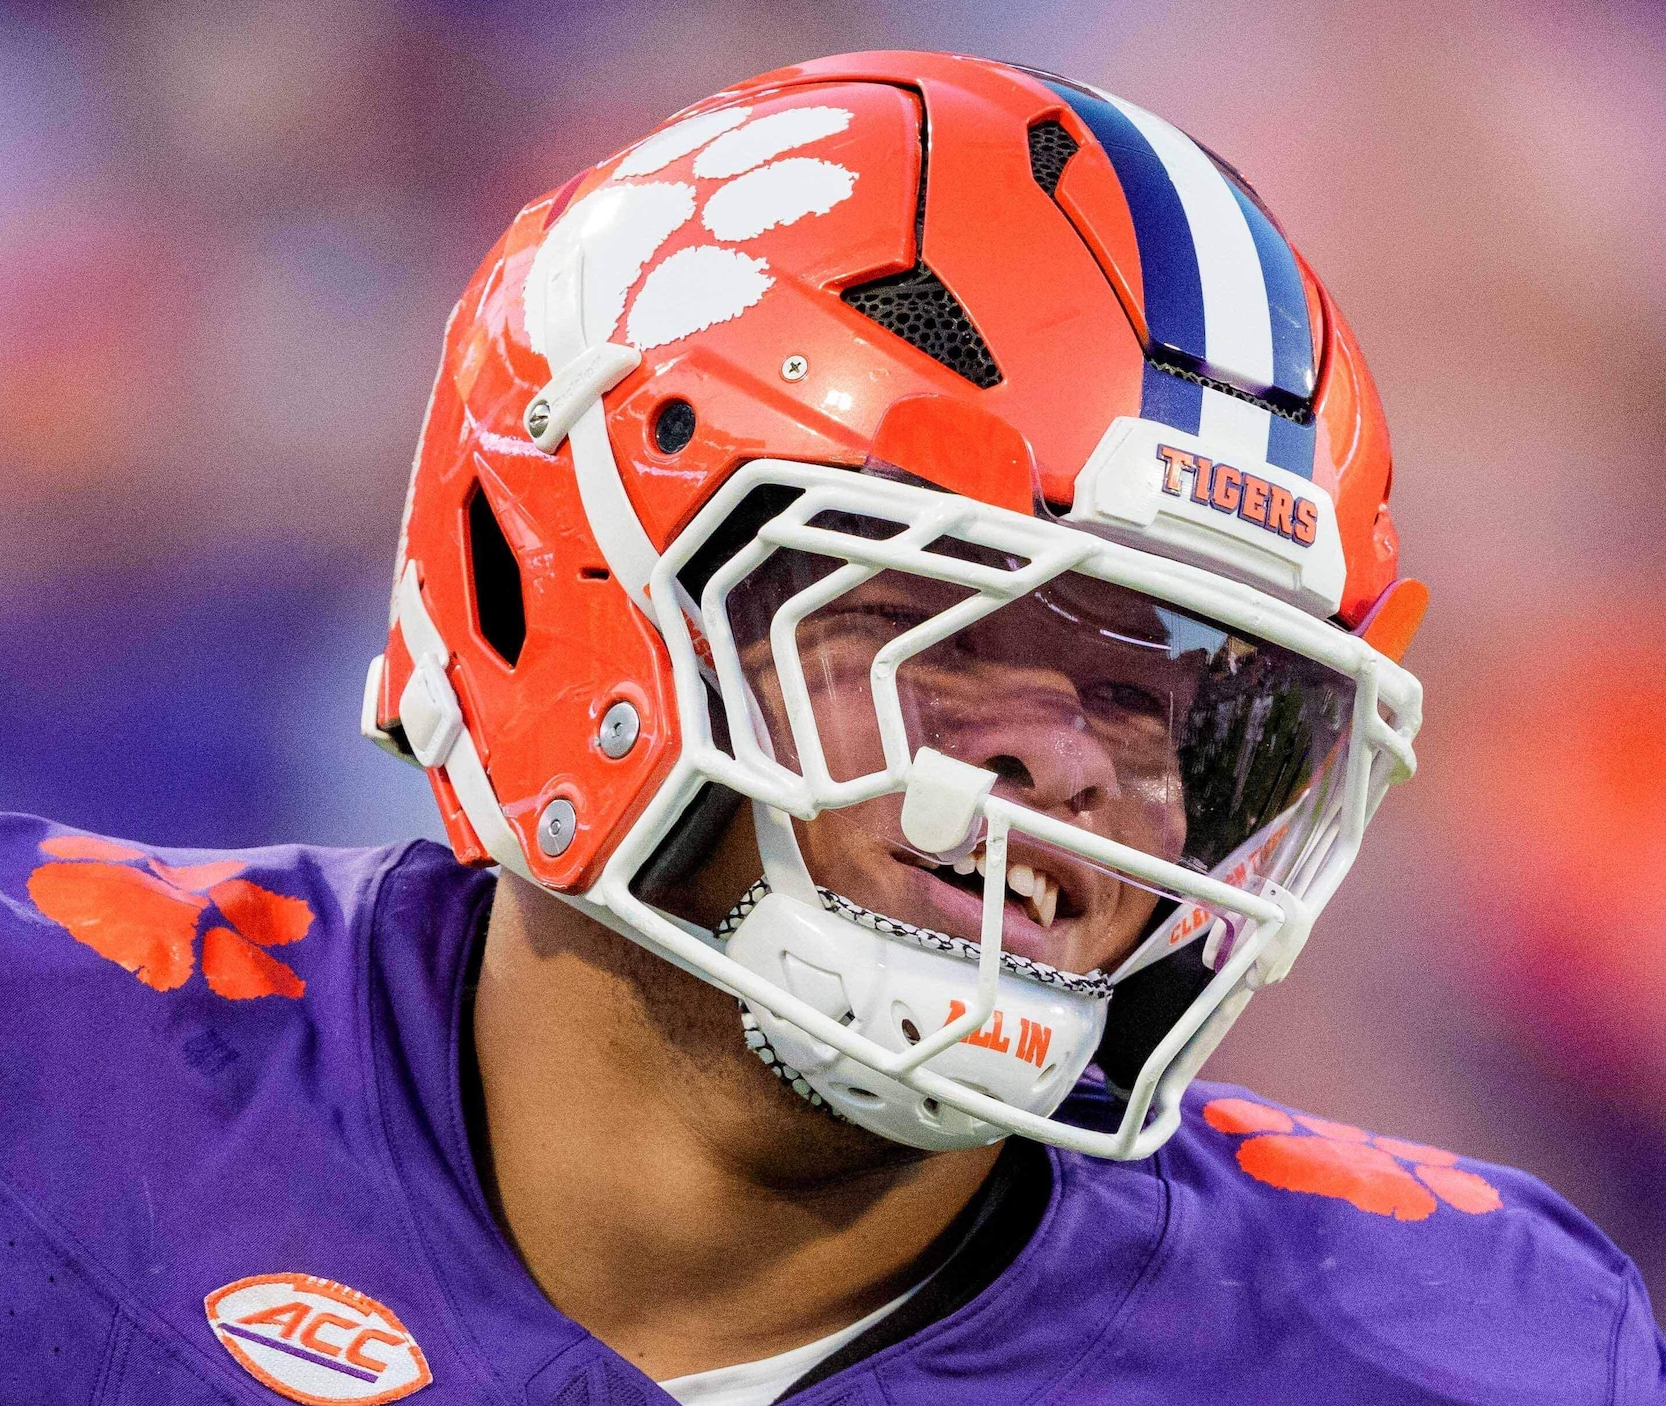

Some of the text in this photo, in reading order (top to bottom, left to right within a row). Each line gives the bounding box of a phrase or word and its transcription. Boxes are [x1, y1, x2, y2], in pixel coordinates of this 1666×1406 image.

[1157, 443, 1319, 549] TIGERS
[1015, 1017, 1052, 1069] IN
[234, 1300, 406, 1374] ACC
